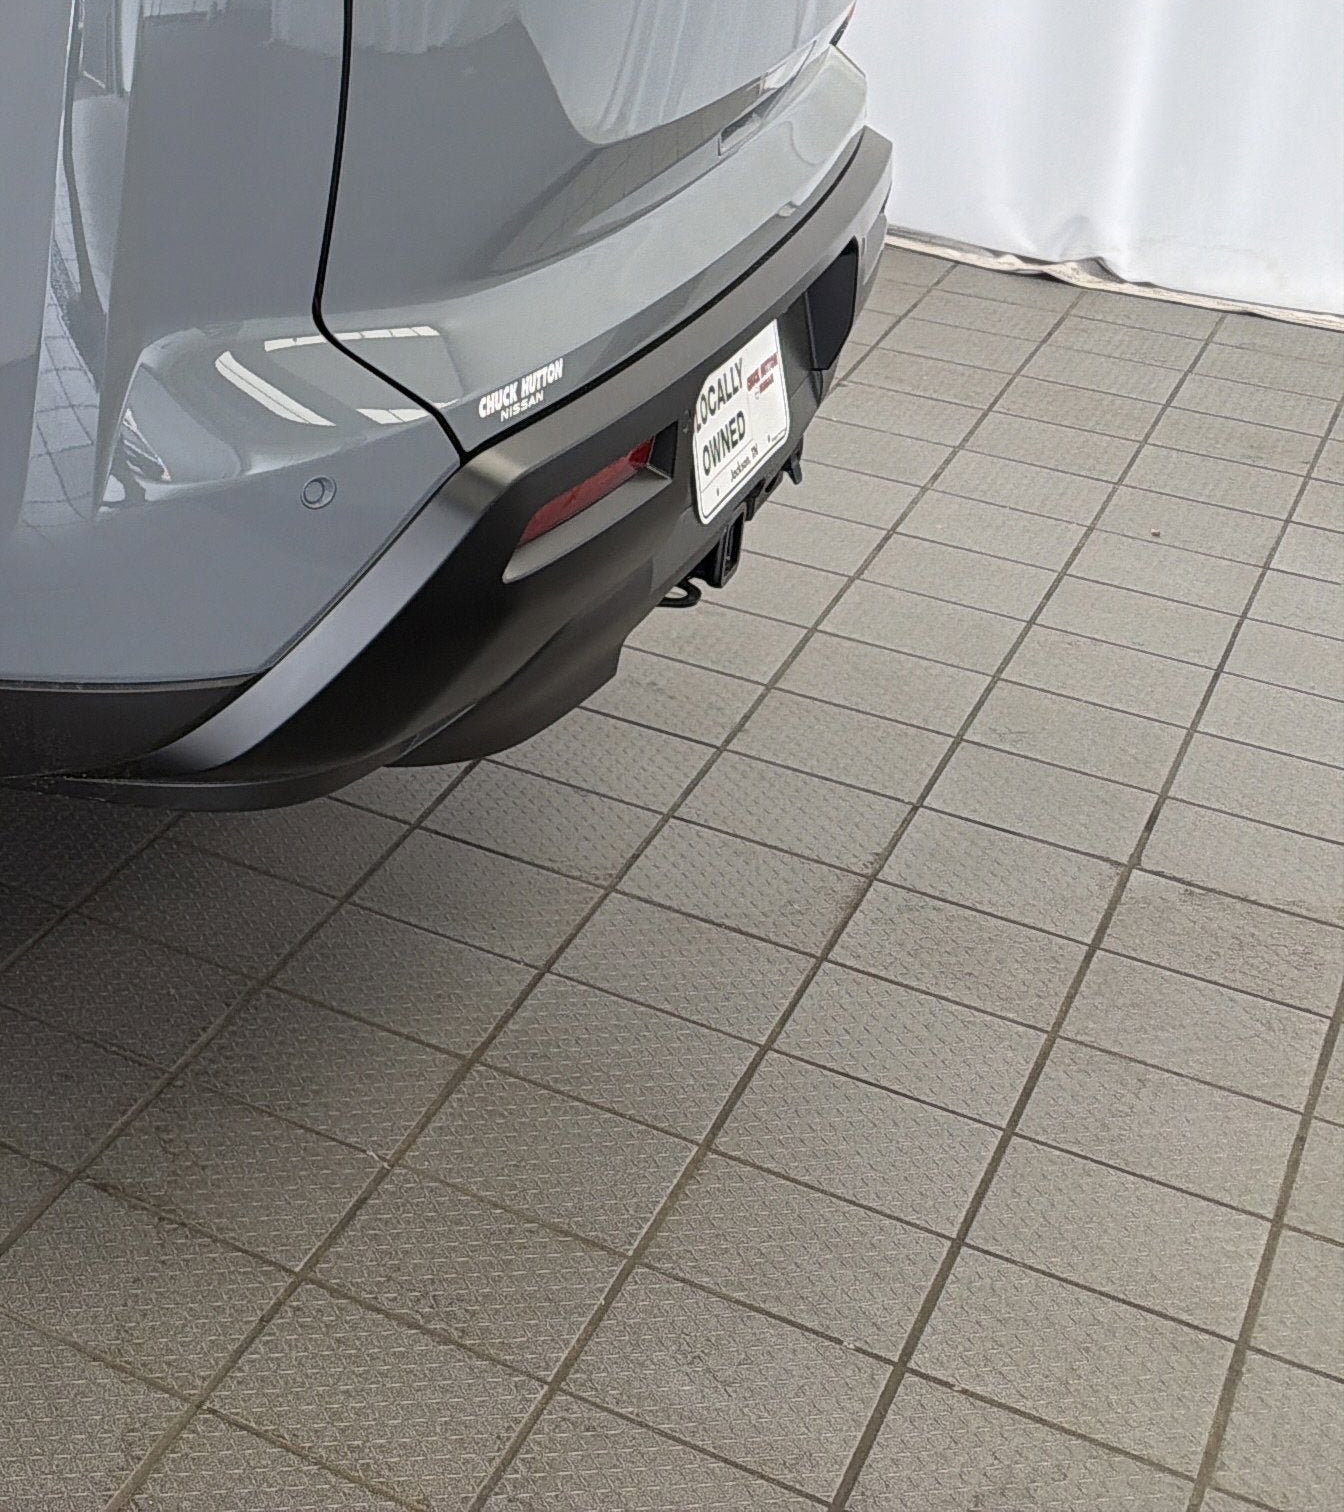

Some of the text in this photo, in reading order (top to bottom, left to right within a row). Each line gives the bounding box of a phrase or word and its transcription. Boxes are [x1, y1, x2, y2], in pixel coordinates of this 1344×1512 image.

[478, 357, 564, 419] CHUCK HUTTON
[500, 389, 544, 423] NISSAN
[695, 357, 744, 434] LOCALLY
[702, 410, 746, 477] OWNED
